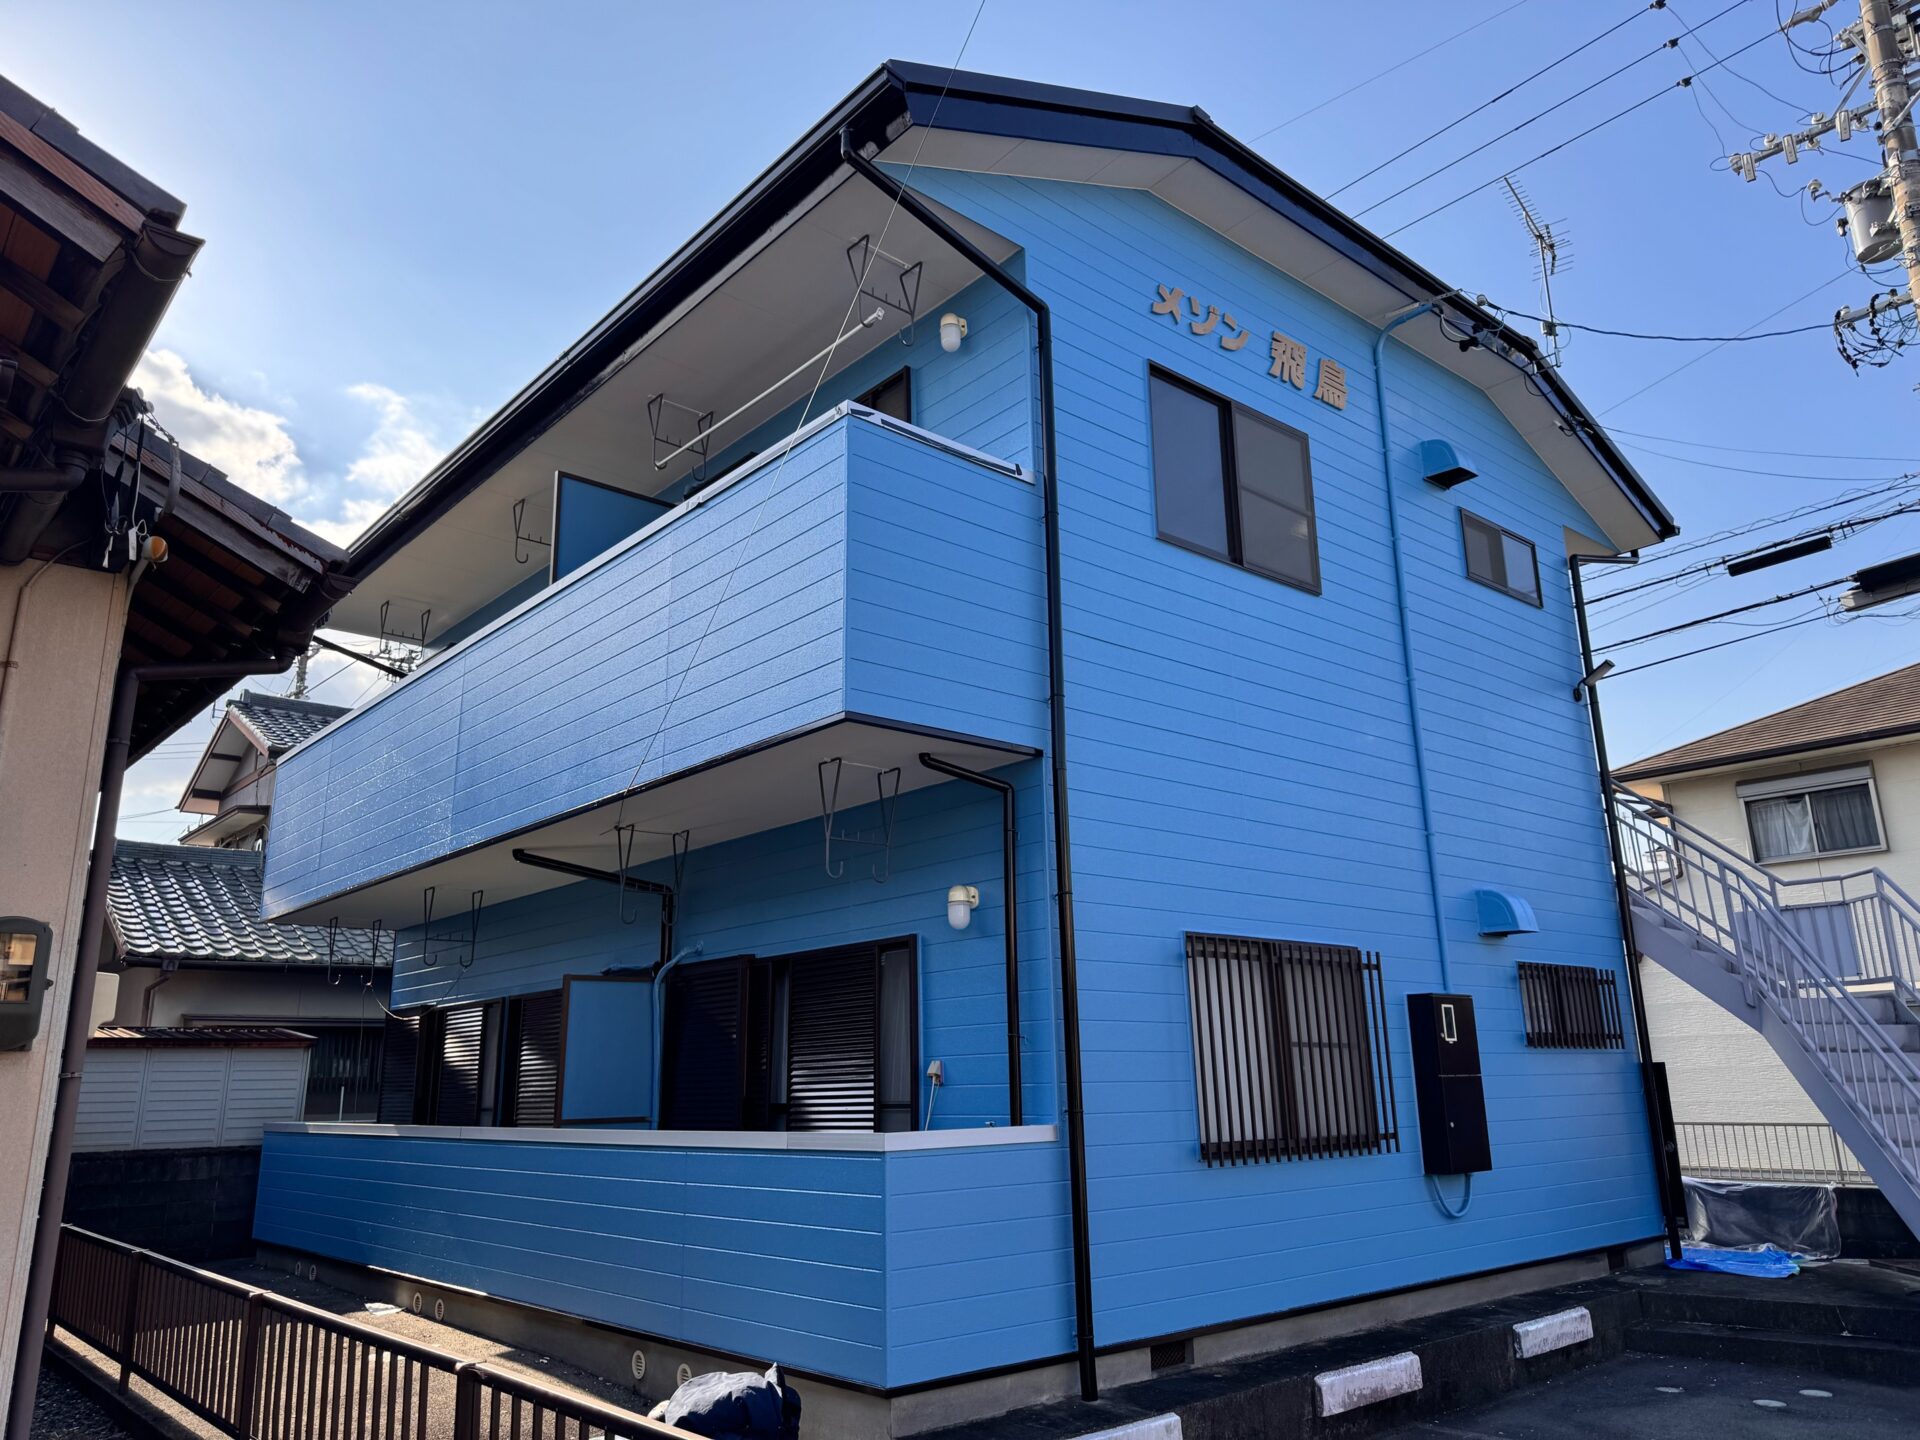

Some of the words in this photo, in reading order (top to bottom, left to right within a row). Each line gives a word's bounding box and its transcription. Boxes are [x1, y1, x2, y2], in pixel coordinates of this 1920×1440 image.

[1152, 283, 1249, 350] メゾン
[1268, 331, 1348, 410] 飛鳥
